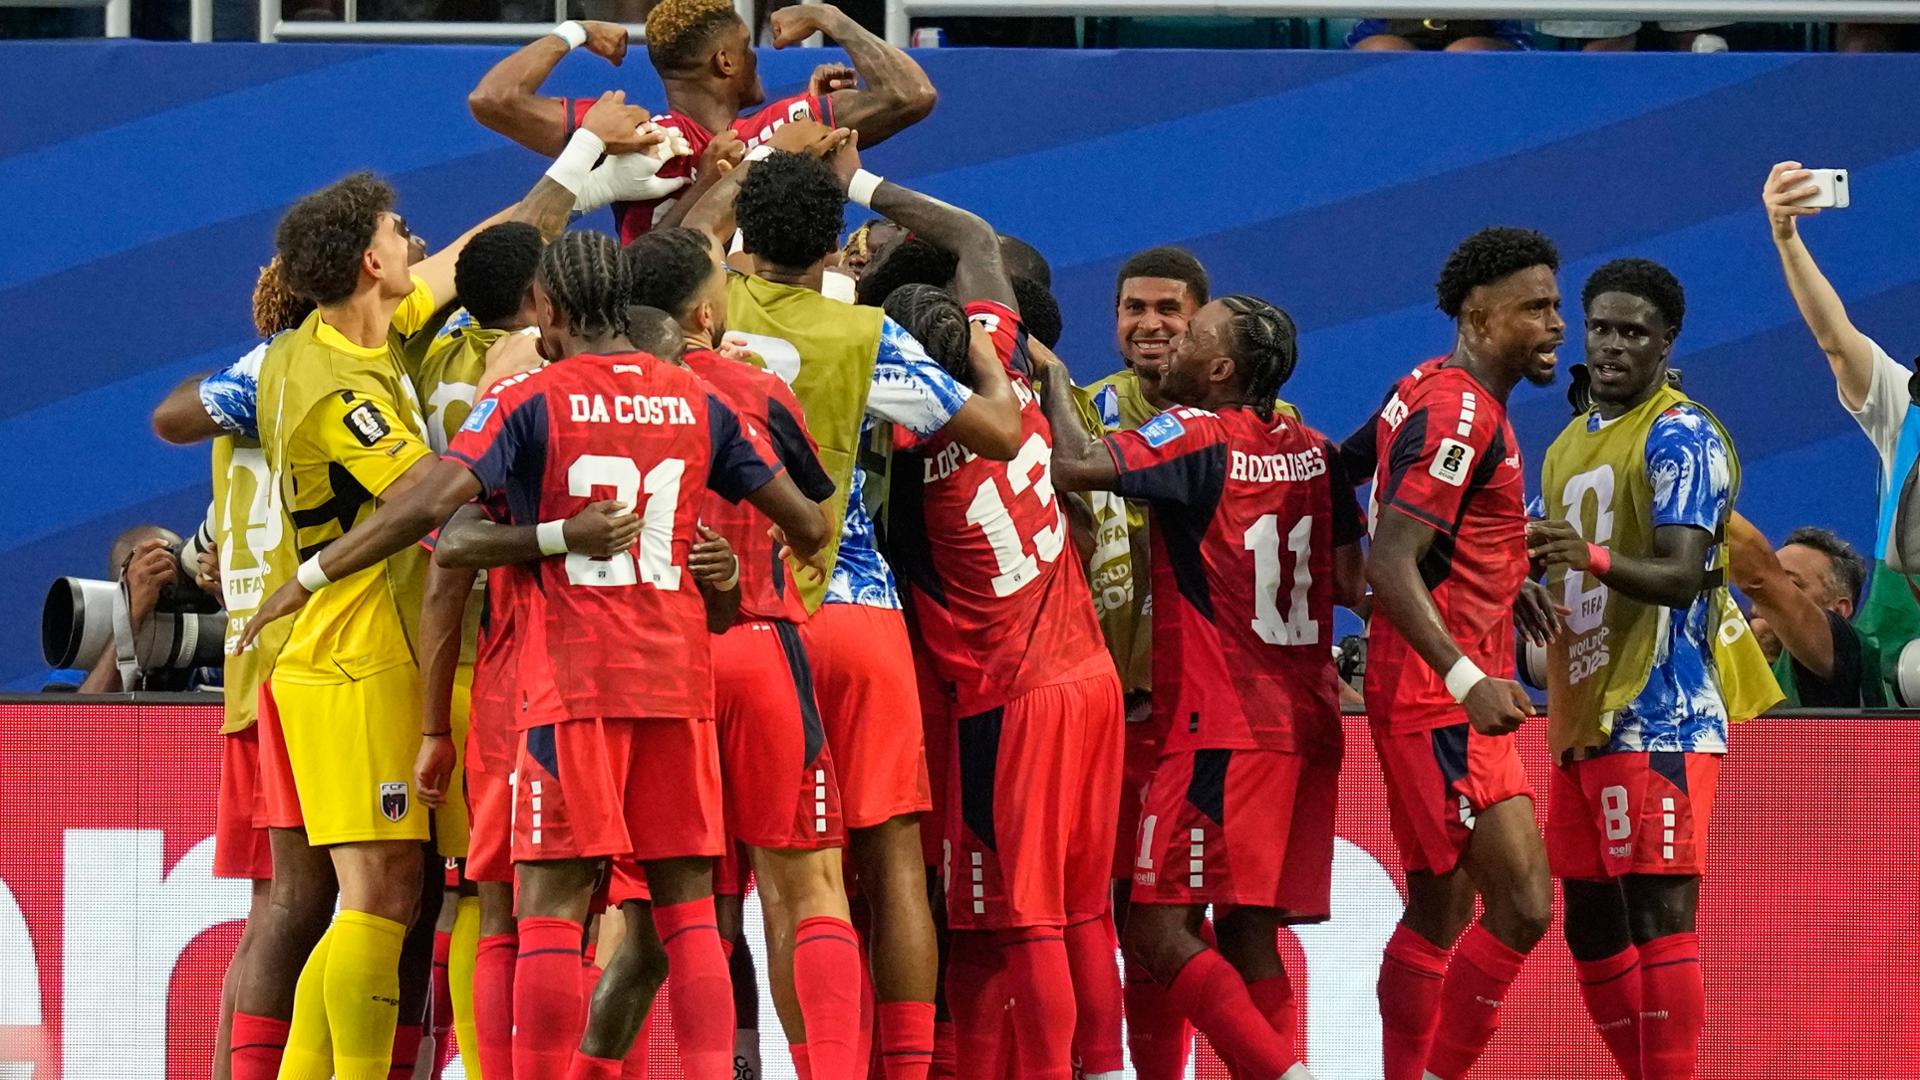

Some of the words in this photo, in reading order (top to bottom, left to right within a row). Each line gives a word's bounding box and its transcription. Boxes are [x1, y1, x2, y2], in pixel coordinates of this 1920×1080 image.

[569, 394, 610, 423] DA
[614, 395, 696, 425] COSTA
[565, 454, 686, 591] 21
[965, 431, 1067, 598] 13
[1244, 514, 1319, 646] 11
[1581, 595, 1603, 618] FIFA
[381, 783, 407, 791] FCF
[1601, 785, 1632, 841] 8
